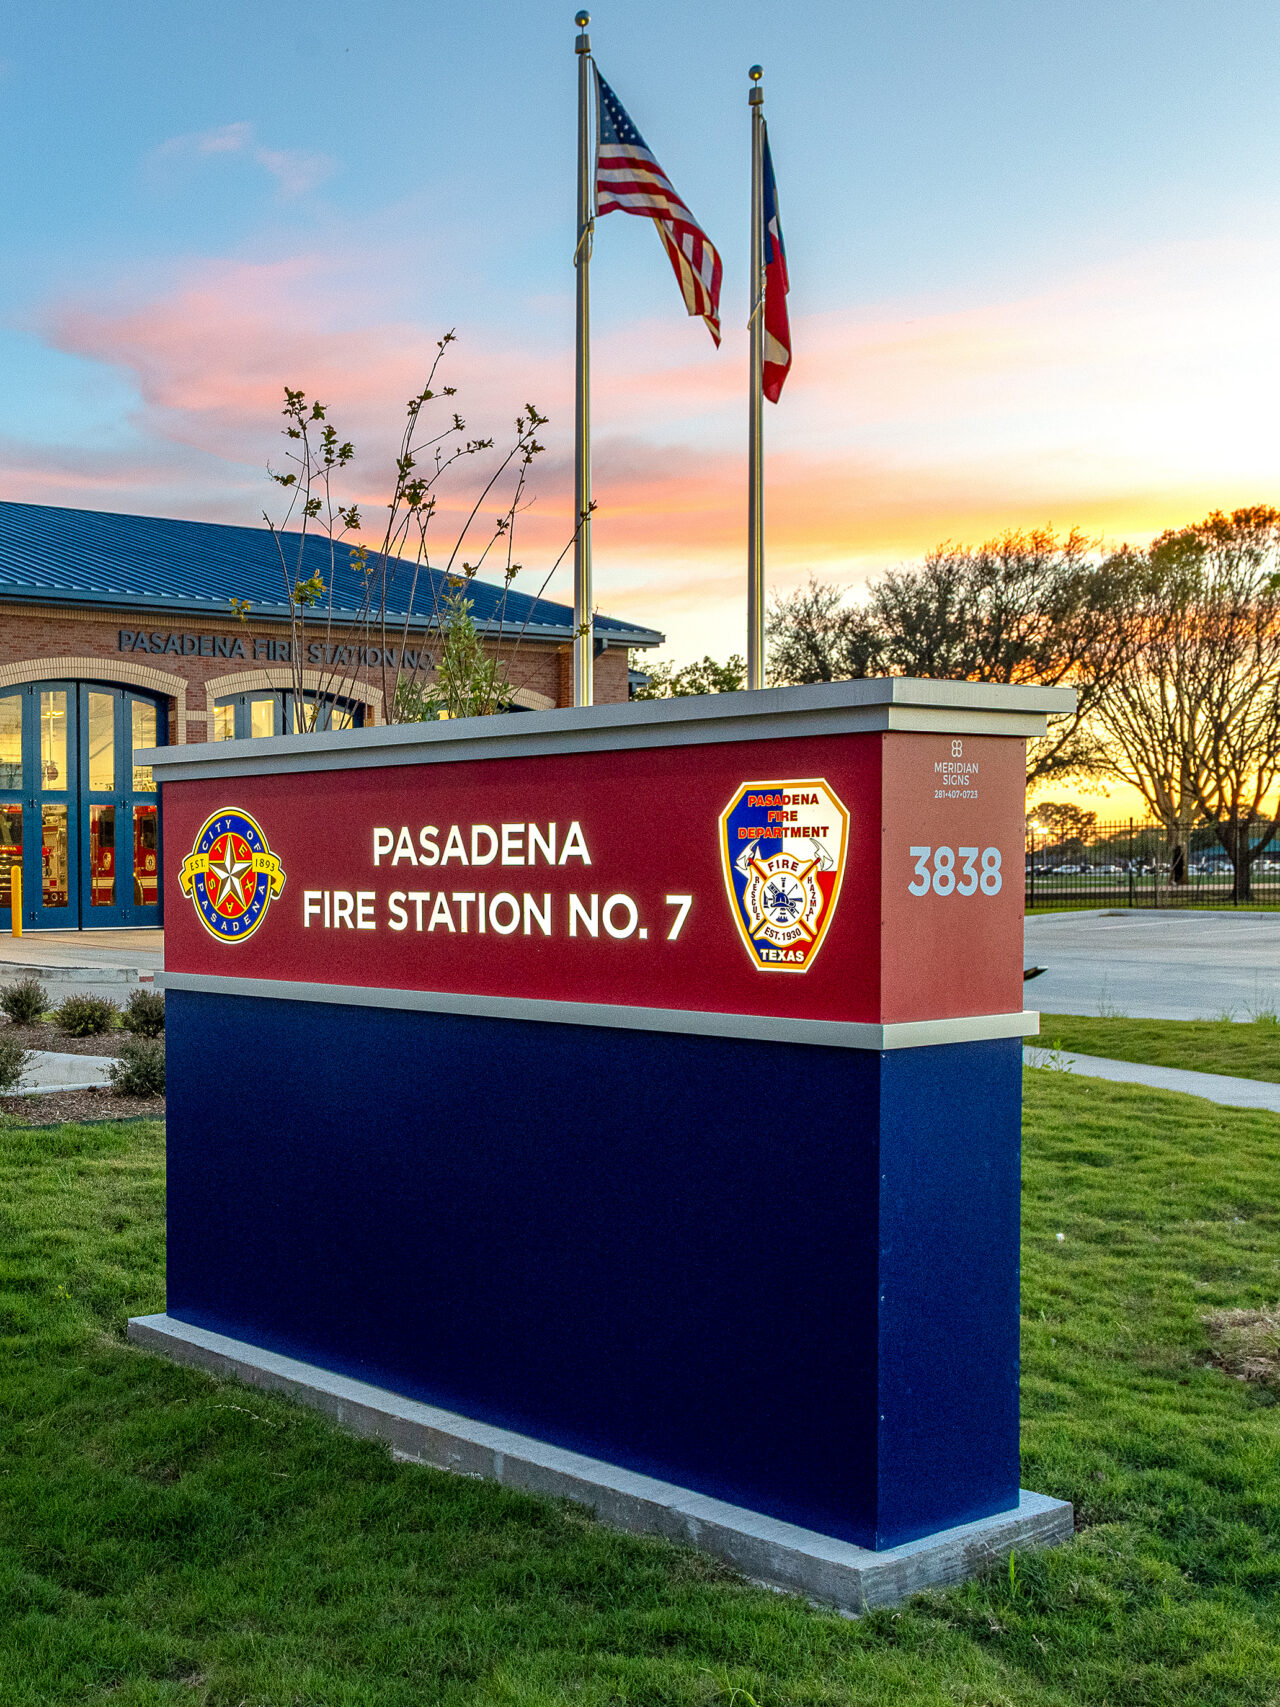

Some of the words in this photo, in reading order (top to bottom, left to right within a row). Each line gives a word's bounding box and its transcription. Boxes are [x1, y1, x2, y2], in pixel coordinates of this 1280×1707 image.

[119, 630, 245, 659] PASADENA
[308, 643, 397, 668] STATION
[934, 762, 979, 774] MERIDIAN
[942, 774, 970, 786] SIGNS
[747, 793, 820, 807] PASADENA
[767, 810, 798, 822] FIRE
[202, 819, 231, 851] CITY
[246, 830, 262, 851] OF
[738, 826, 829, 839] DEPARTMENT
[373, 821, 592, 866] PASADENA
[189, 858, 206, 871] EST.
[255, 858, 275, 872] 1893
[767, 859, 799, 872] FIRE
[908, 846, 1002, 897] 3838
[751, 876, 760, 920] RESCUE
[805, 876, 816, 921] HAZMAT
[197, 883, 266, 931] PASADENA
[304, 891, 376, 930] FIRE
[388, 890, 552, 937] STATION
[569, 893, 648, 940] NO.
[666, 895, 693, 940] 7
[764, 926, 781, 940] EST.
[782, 928, 802, 941] 1930
[759, 948, 804, 962] TEXAS
